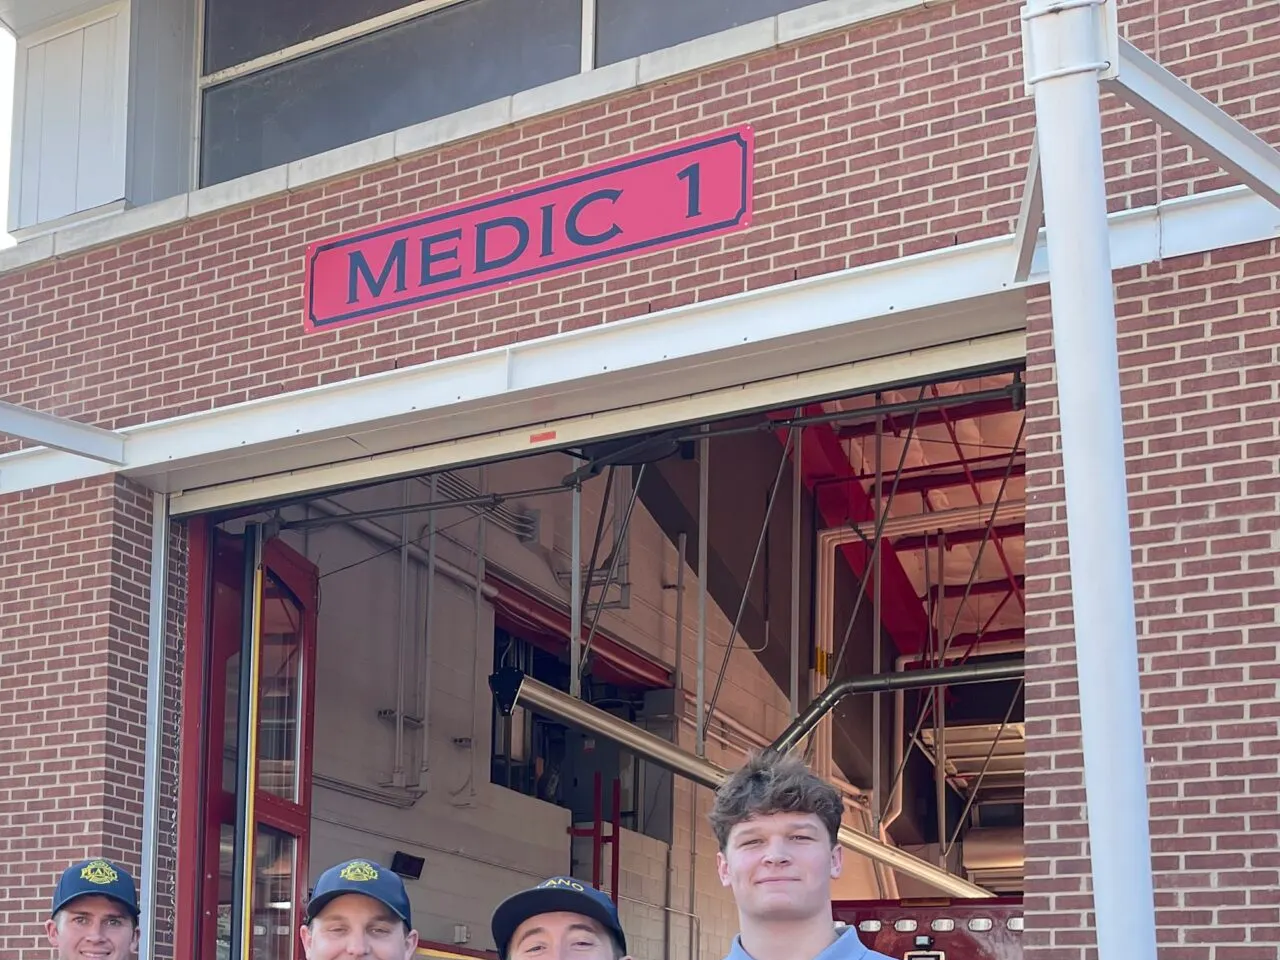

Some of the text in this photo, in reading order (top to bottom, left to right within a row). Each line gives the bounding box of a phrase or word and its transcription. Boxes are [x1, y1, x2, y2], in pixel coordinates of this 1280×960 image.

[346, 161, 702, 305] MEDIC 1
[80, 868, 119, 882] PLANO
[340, 868, 378, 880] PLANO
